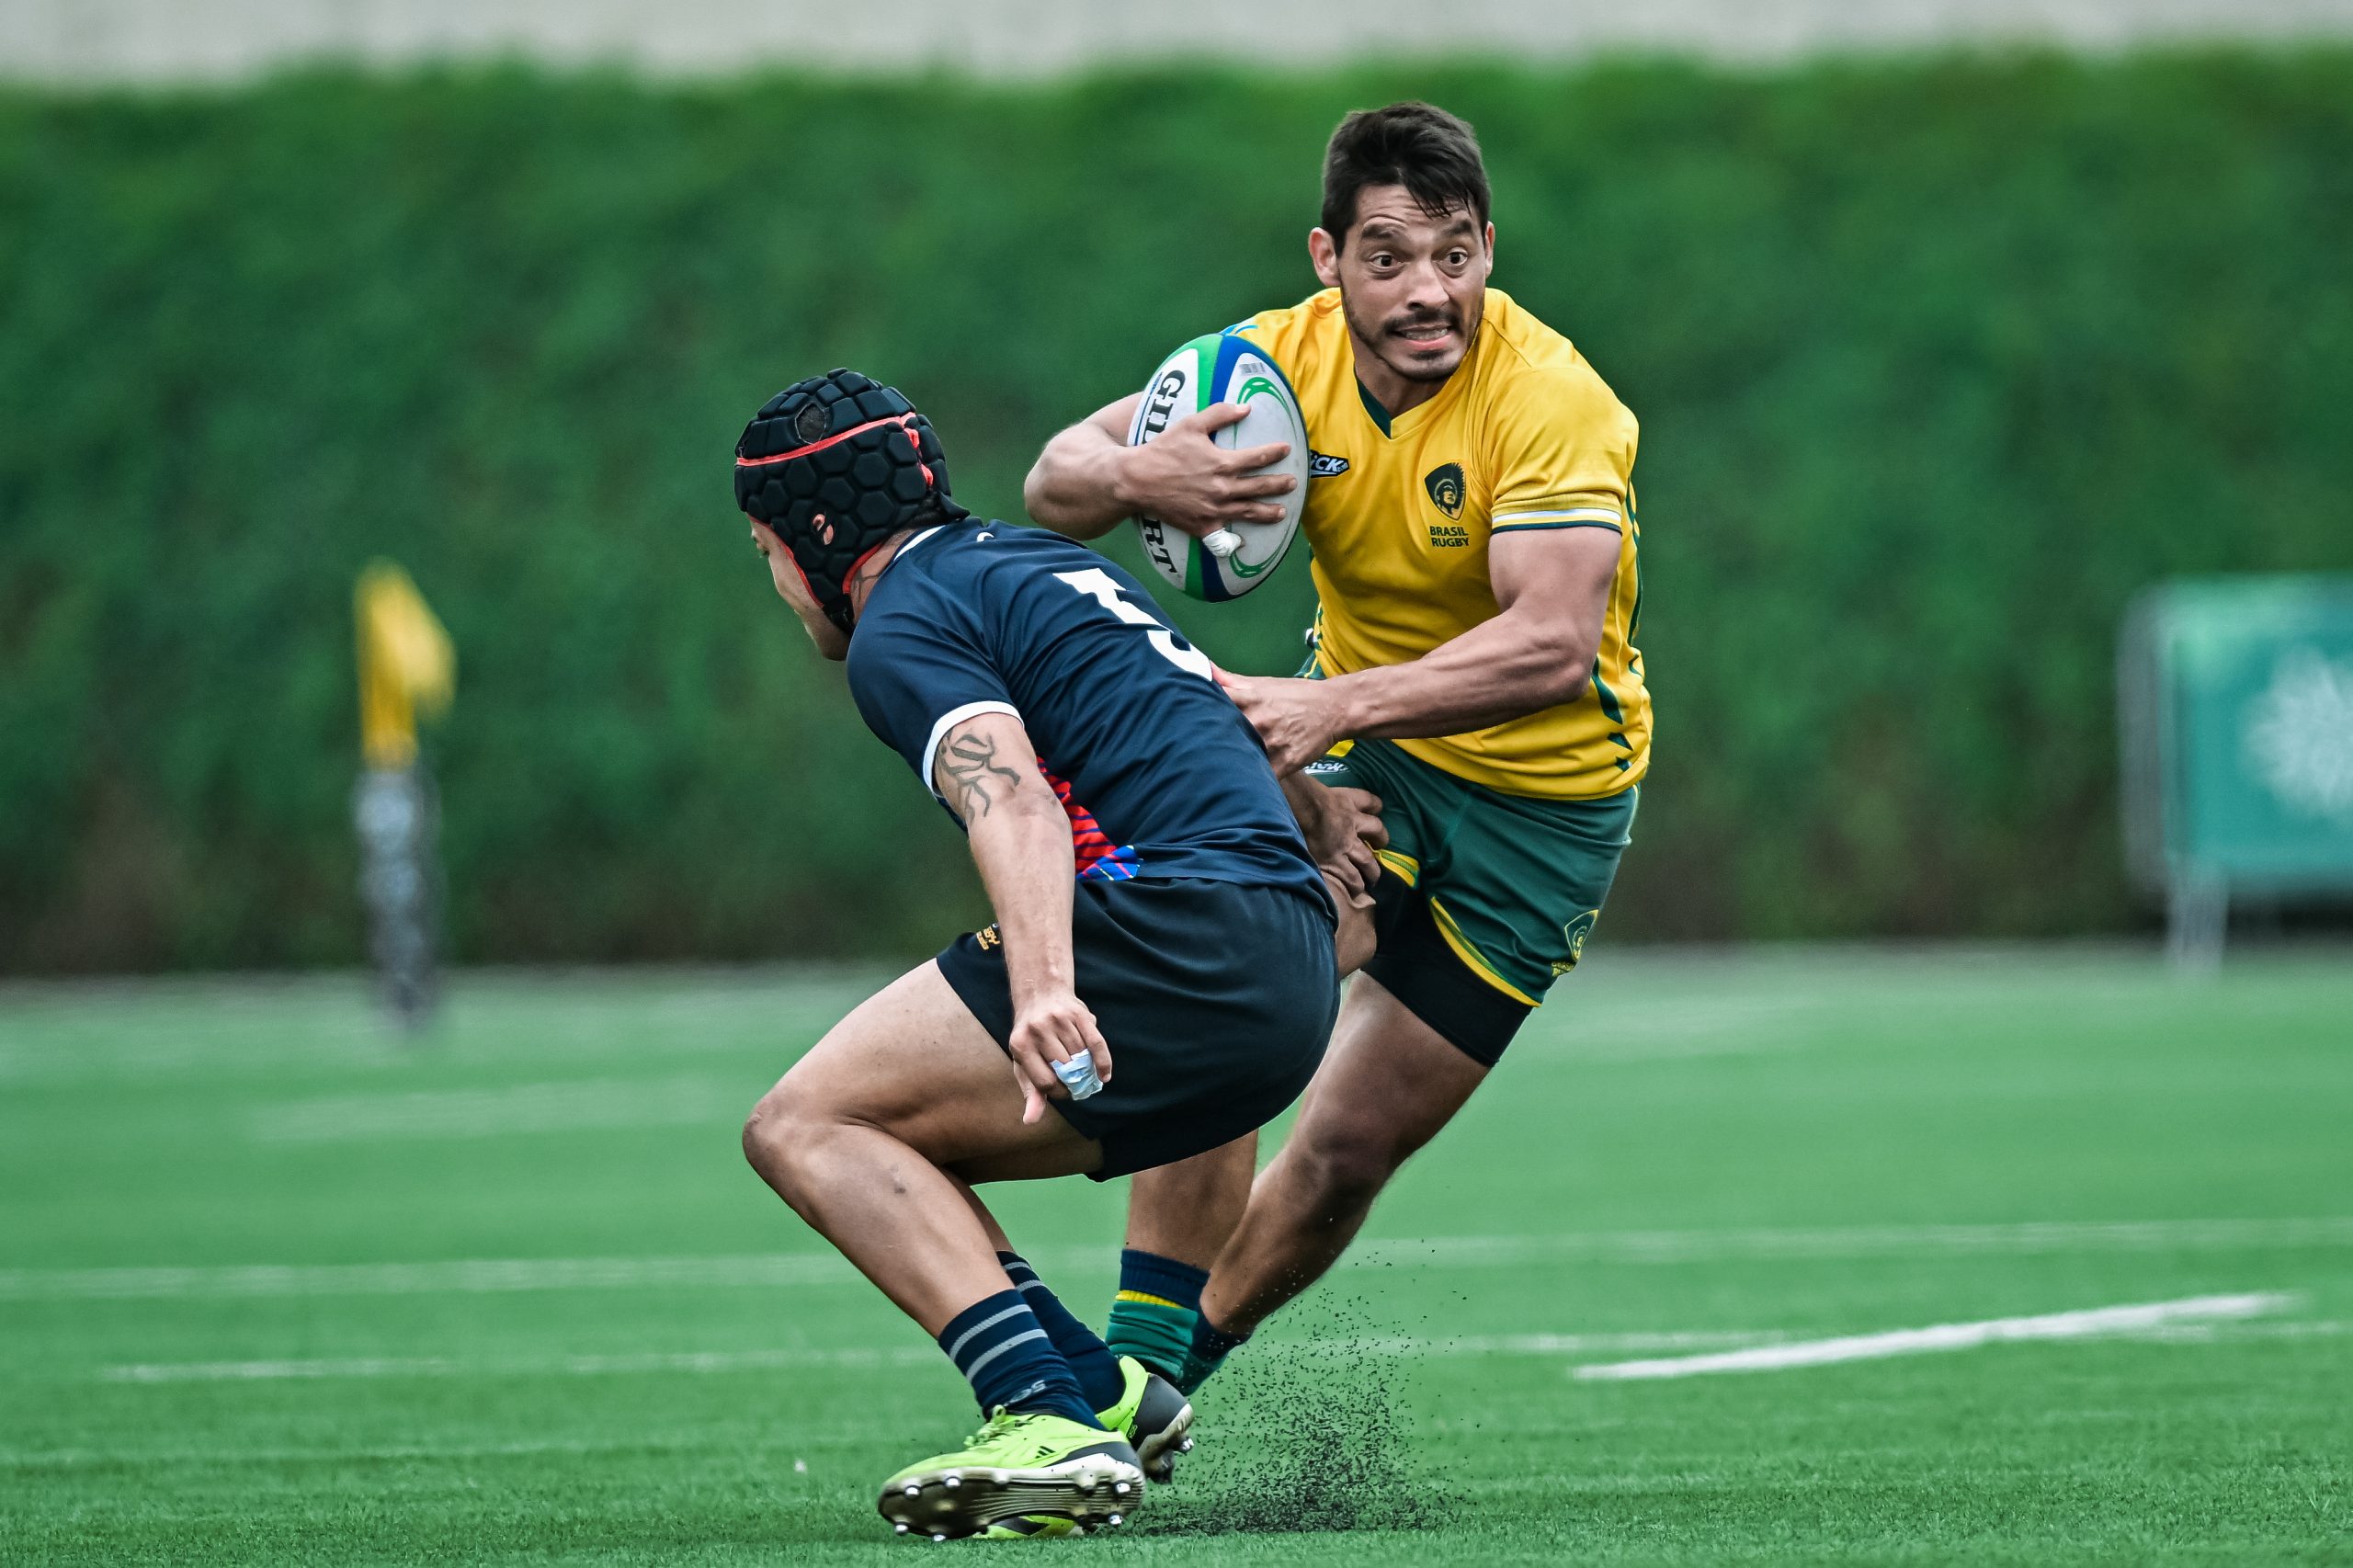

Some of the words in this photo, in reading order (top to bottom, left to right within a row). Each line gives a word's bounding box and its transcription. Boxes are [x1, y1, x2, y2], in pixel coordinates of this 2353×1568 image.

[1142, 369, 1186, 574] GILRT
[1429, 526, 1469, 536] BRASIL
[1431, 537, 1470, 547] RUGBY
